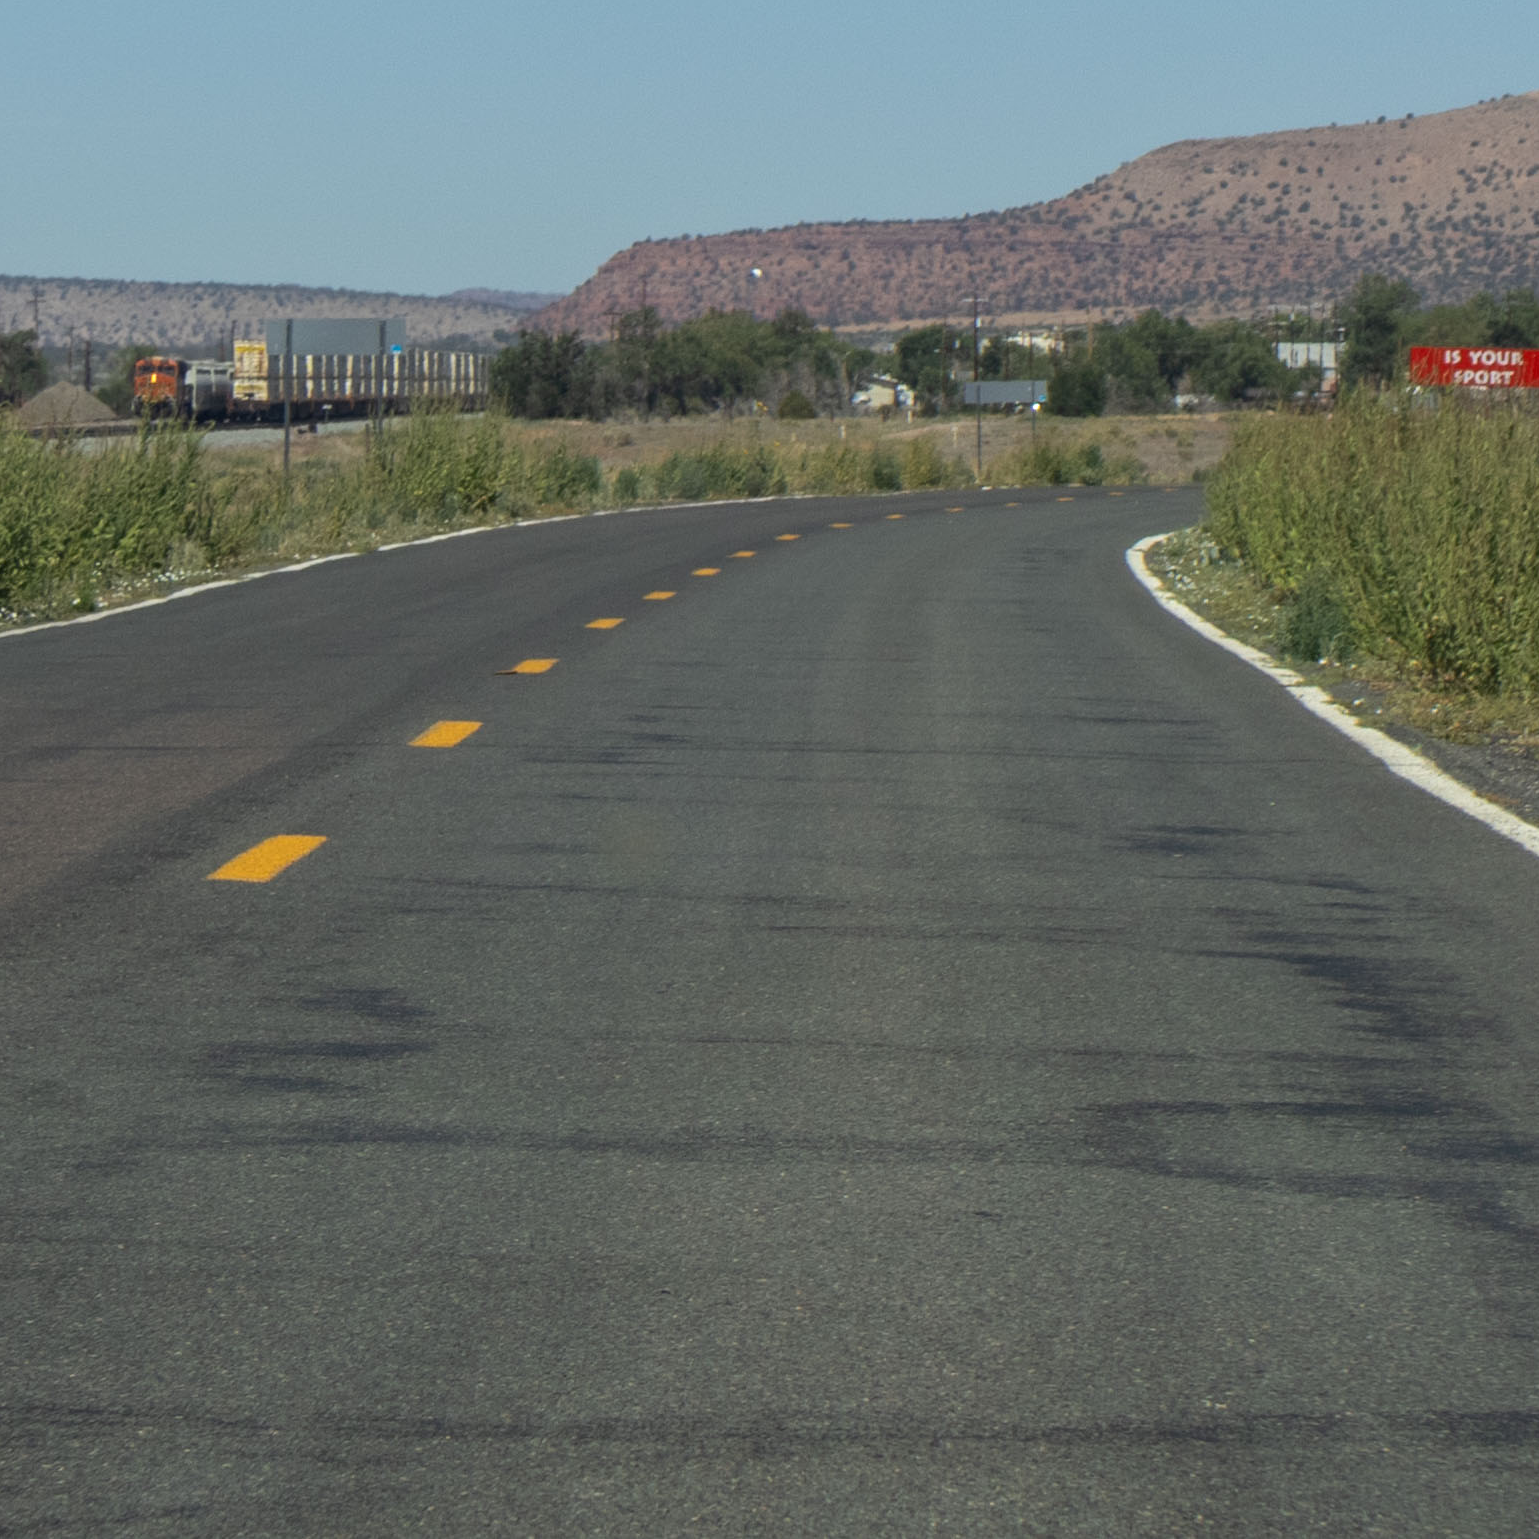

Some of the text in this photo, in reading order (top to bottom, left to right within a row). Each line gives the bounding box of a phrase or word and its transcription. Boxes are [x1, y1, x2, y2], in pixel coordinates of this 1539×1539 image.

[1444, 349, 1524, 366] IS YOUR
[1454, 370, 1514, 385] SPORT
